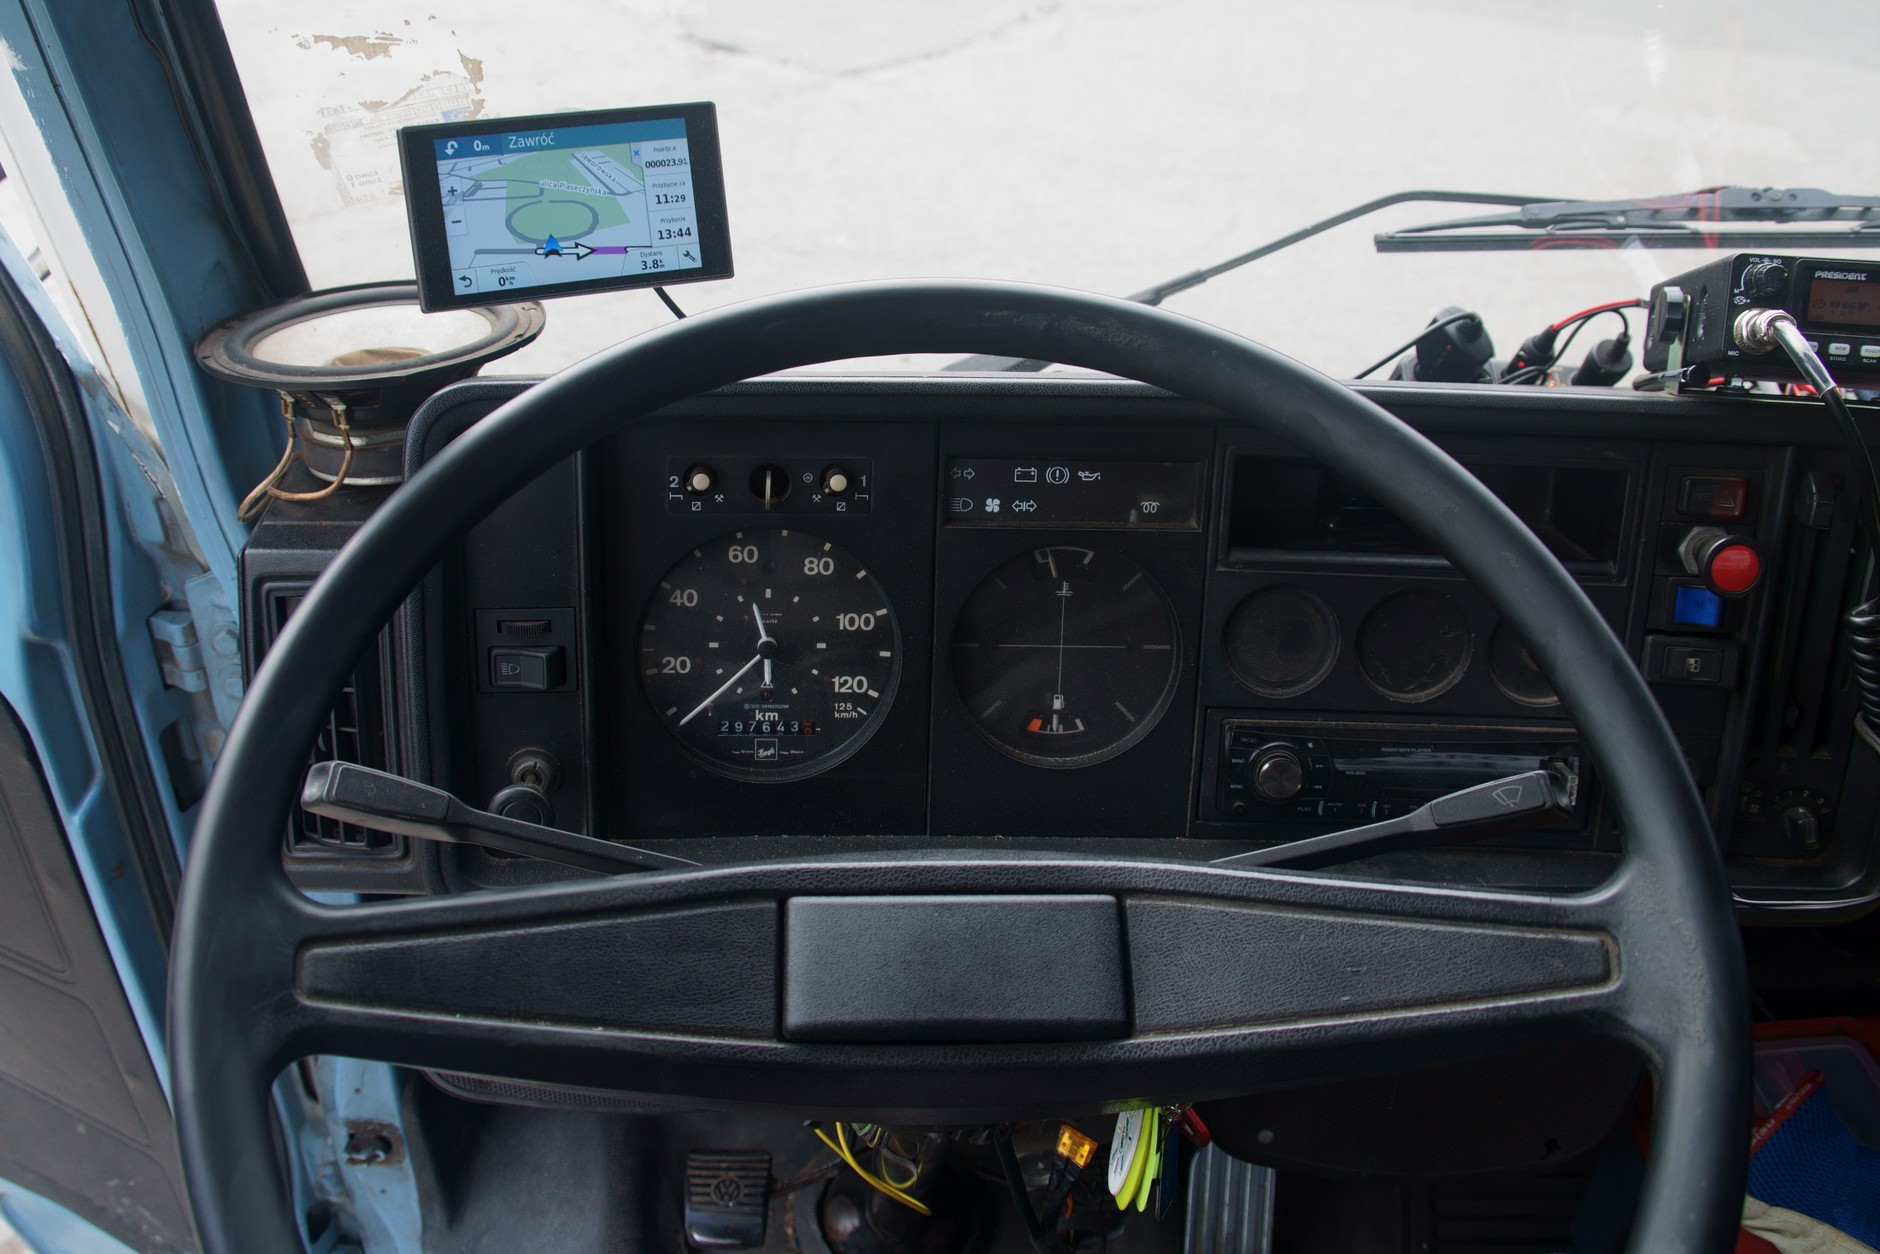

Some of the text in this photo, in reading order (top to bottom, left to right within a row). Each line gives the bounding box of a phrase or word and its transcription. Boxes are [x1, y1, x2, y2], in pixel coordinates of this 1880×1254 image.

[508, 132, 555, 149] Zawróć
[580, 152, 617, 183] Jaworowska
[540, 180, 607, 197] ulica Piaseczyńska
[652, 182, 678, 190] Przybycie
[655, 193, 686, 205] 11:29
[660, 215, 686, 225] Przybycie
[657, 227, 692, 240] 13:44
[640, 251, 663, 259] Dystans
[490, 266, 516, 275] Prędkość
[1814, 270, 1868, 281] PRESIDENT
[669, 475, 679, 488] 2
[860, 475, 867, 487] 1
[728, 545, 759, 564] 60
[803, 557, 834, 576] 80
[669, 589, 699, 608] 40
[835, 613, 875, 631] 100
[661, 656, 691, 674] 20
[831, 676, 868, 693] 120
[755, 709, 779, 721] km
[834, 711, 859, 720] km/h
